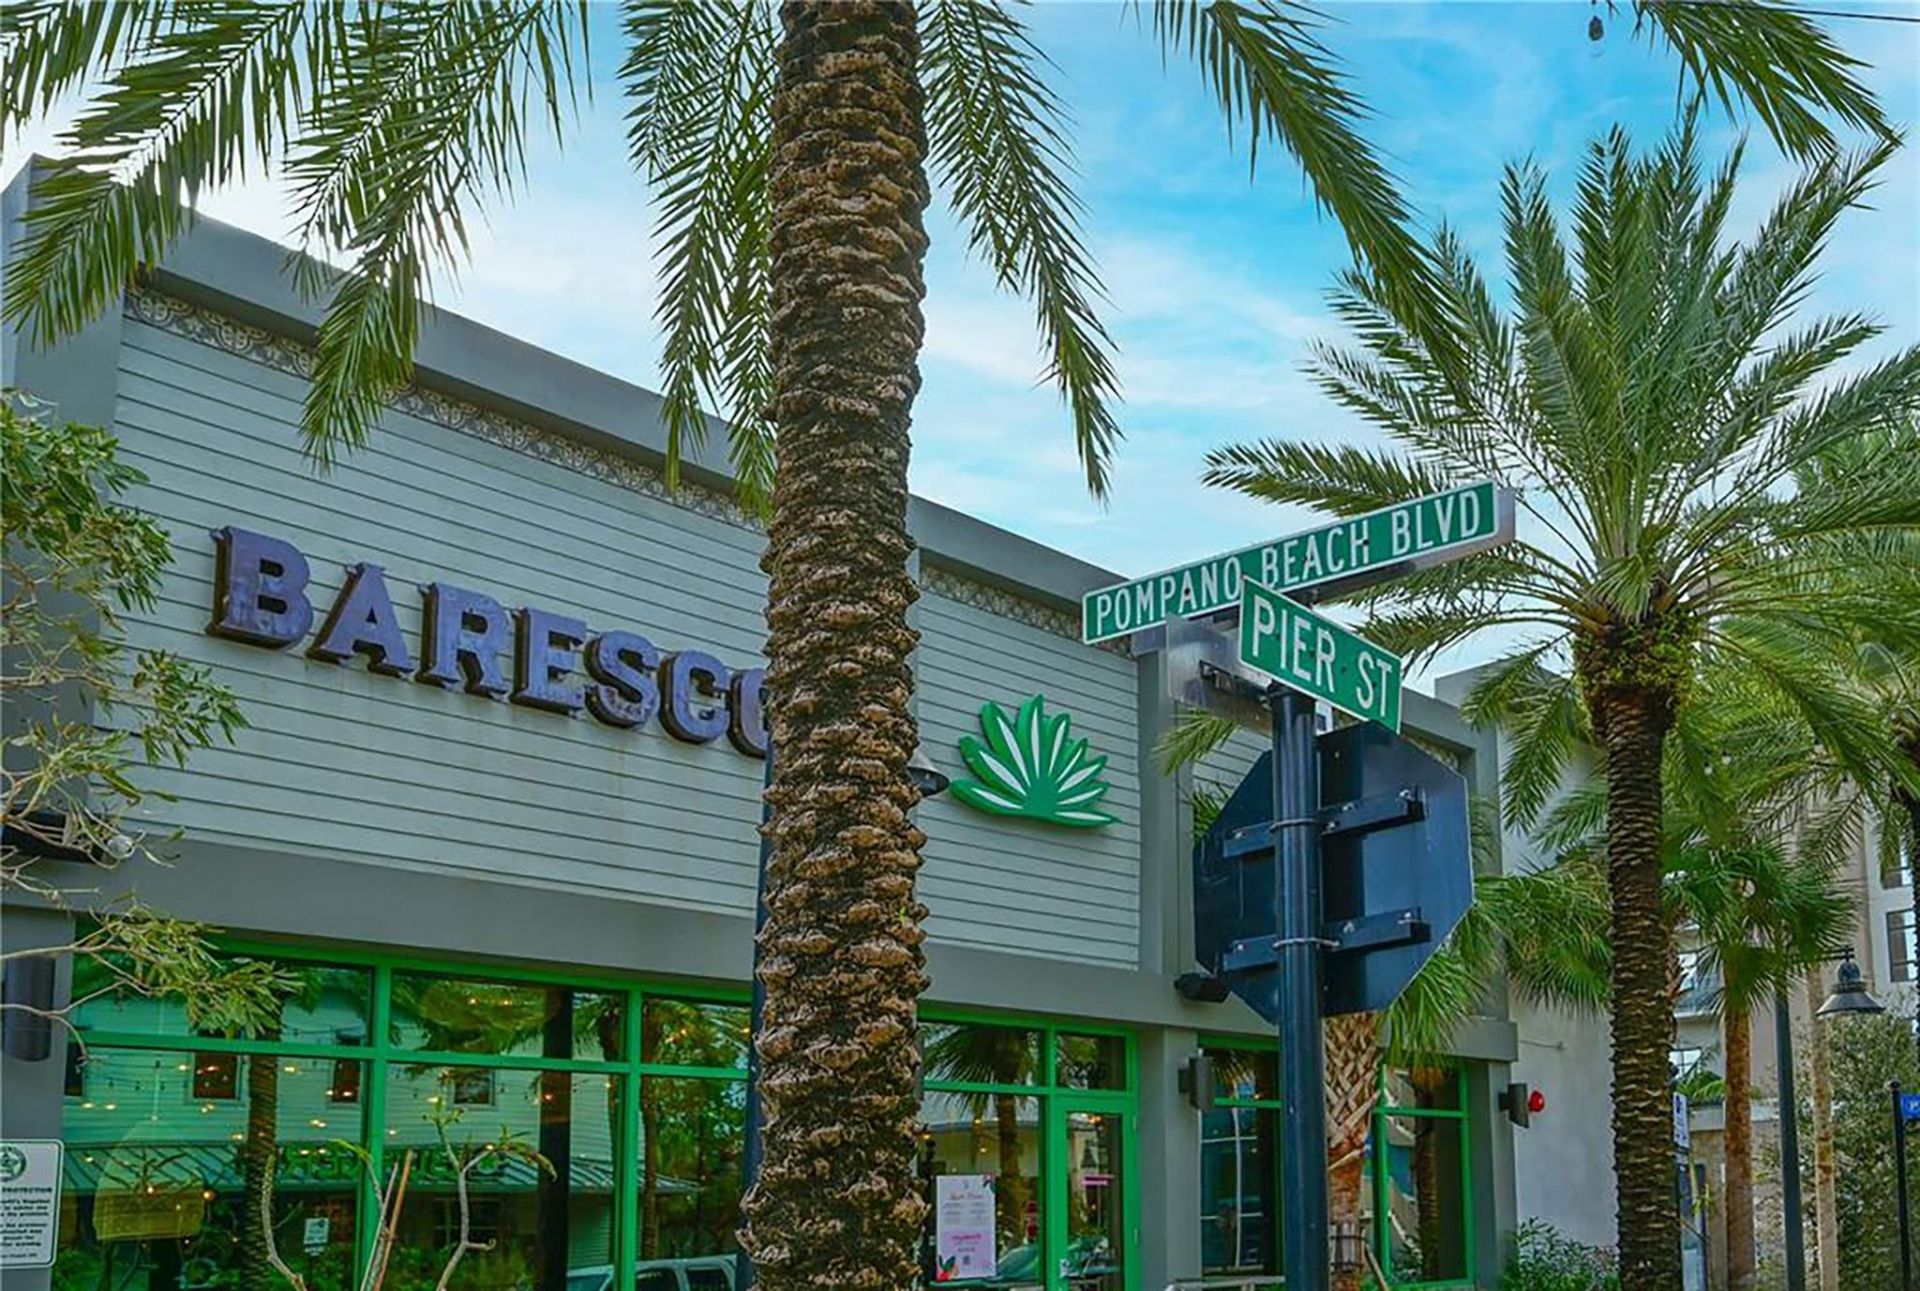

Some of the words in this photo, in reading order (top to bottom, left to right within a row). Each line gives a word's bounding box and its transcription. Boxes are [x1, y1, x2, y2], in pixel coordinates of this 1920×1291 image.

[1097, 555, 1241, 631] POMPANO
[1261, 520, 1370, 590] BEACH
[1391, 489, 1480, 557] BLVD
[1251, 595, 1336, 693] PIER
[1355, 650, 1393, 718] ST
